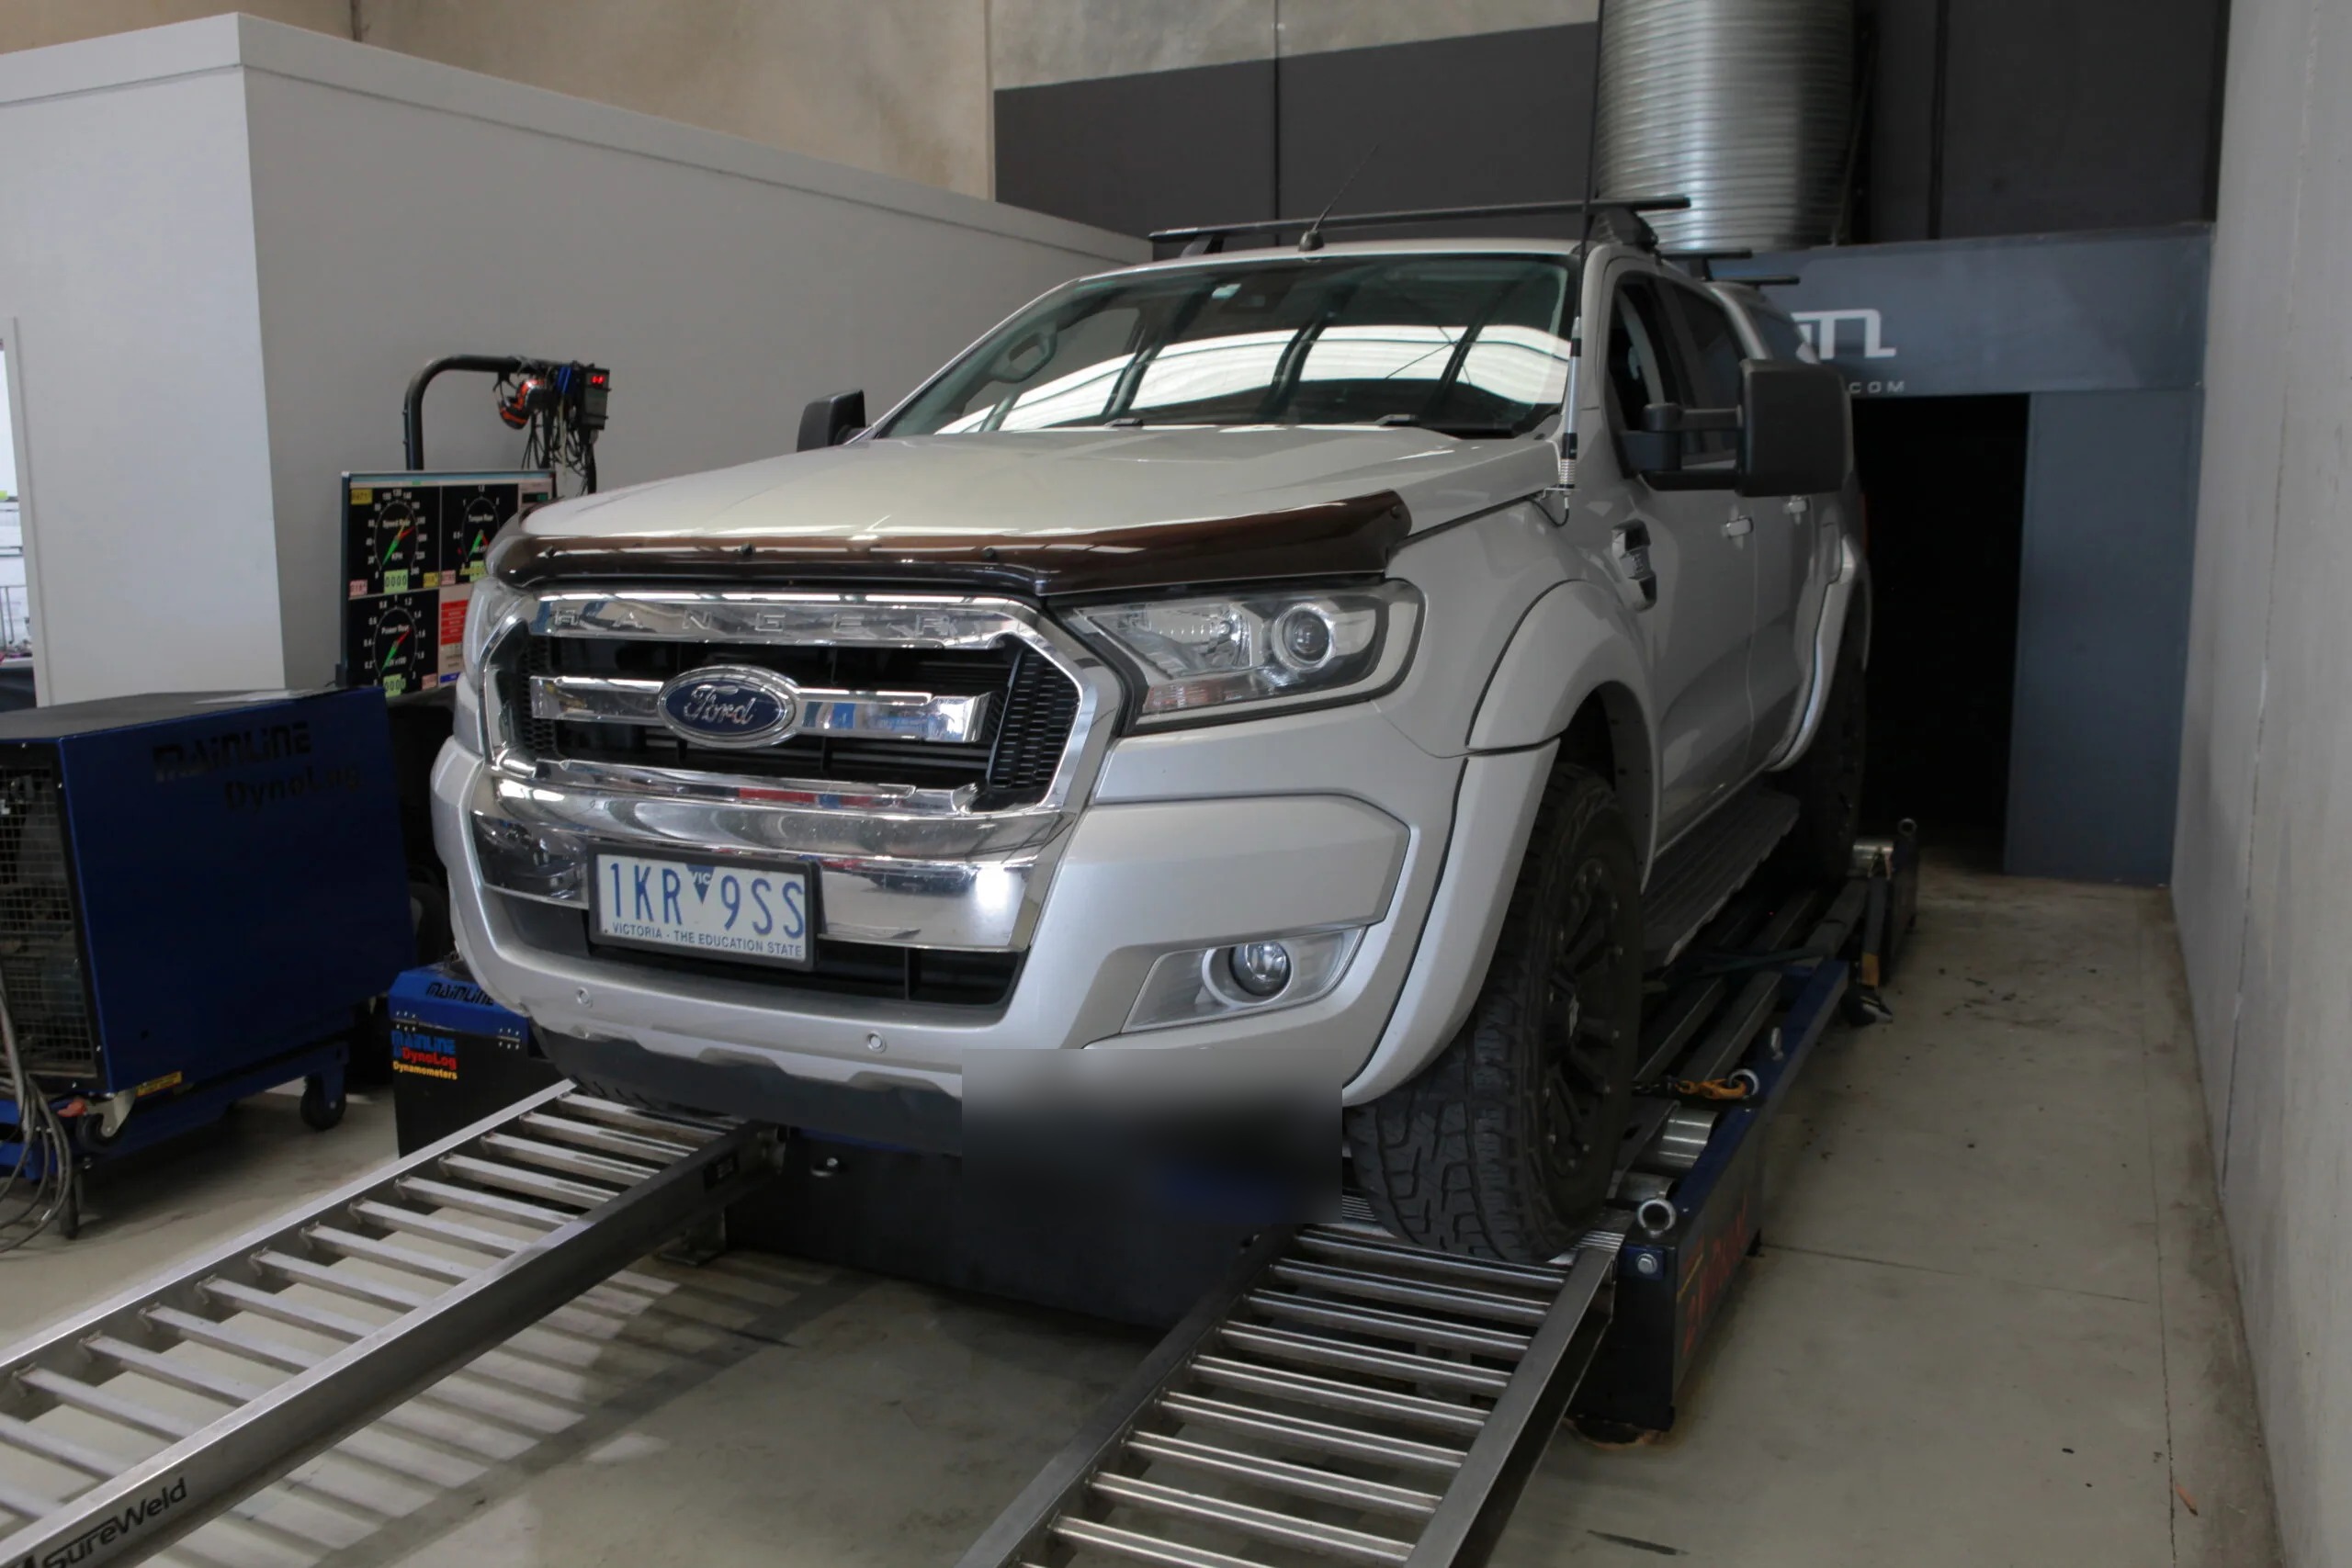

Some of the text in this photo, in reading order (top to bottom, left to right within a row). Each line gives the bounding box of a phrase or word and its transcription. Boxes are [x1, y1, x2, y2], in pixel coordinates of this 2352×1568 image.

[684, 684, 757, 725] Ford
[691, 871, 713, 886] VIC
[610, 862, 805, 941] 1KR 9SS
[612, 921, 662, 939] VICTORIA
[673, 931, 695, 944] THE
[698, 933, 763, 953] EDUCATION
[767, 942, 803, 957] STATE
[392, 1060, 458, 1080] Dynamometers
[401, 1047, 457, 1070] DynoLog
